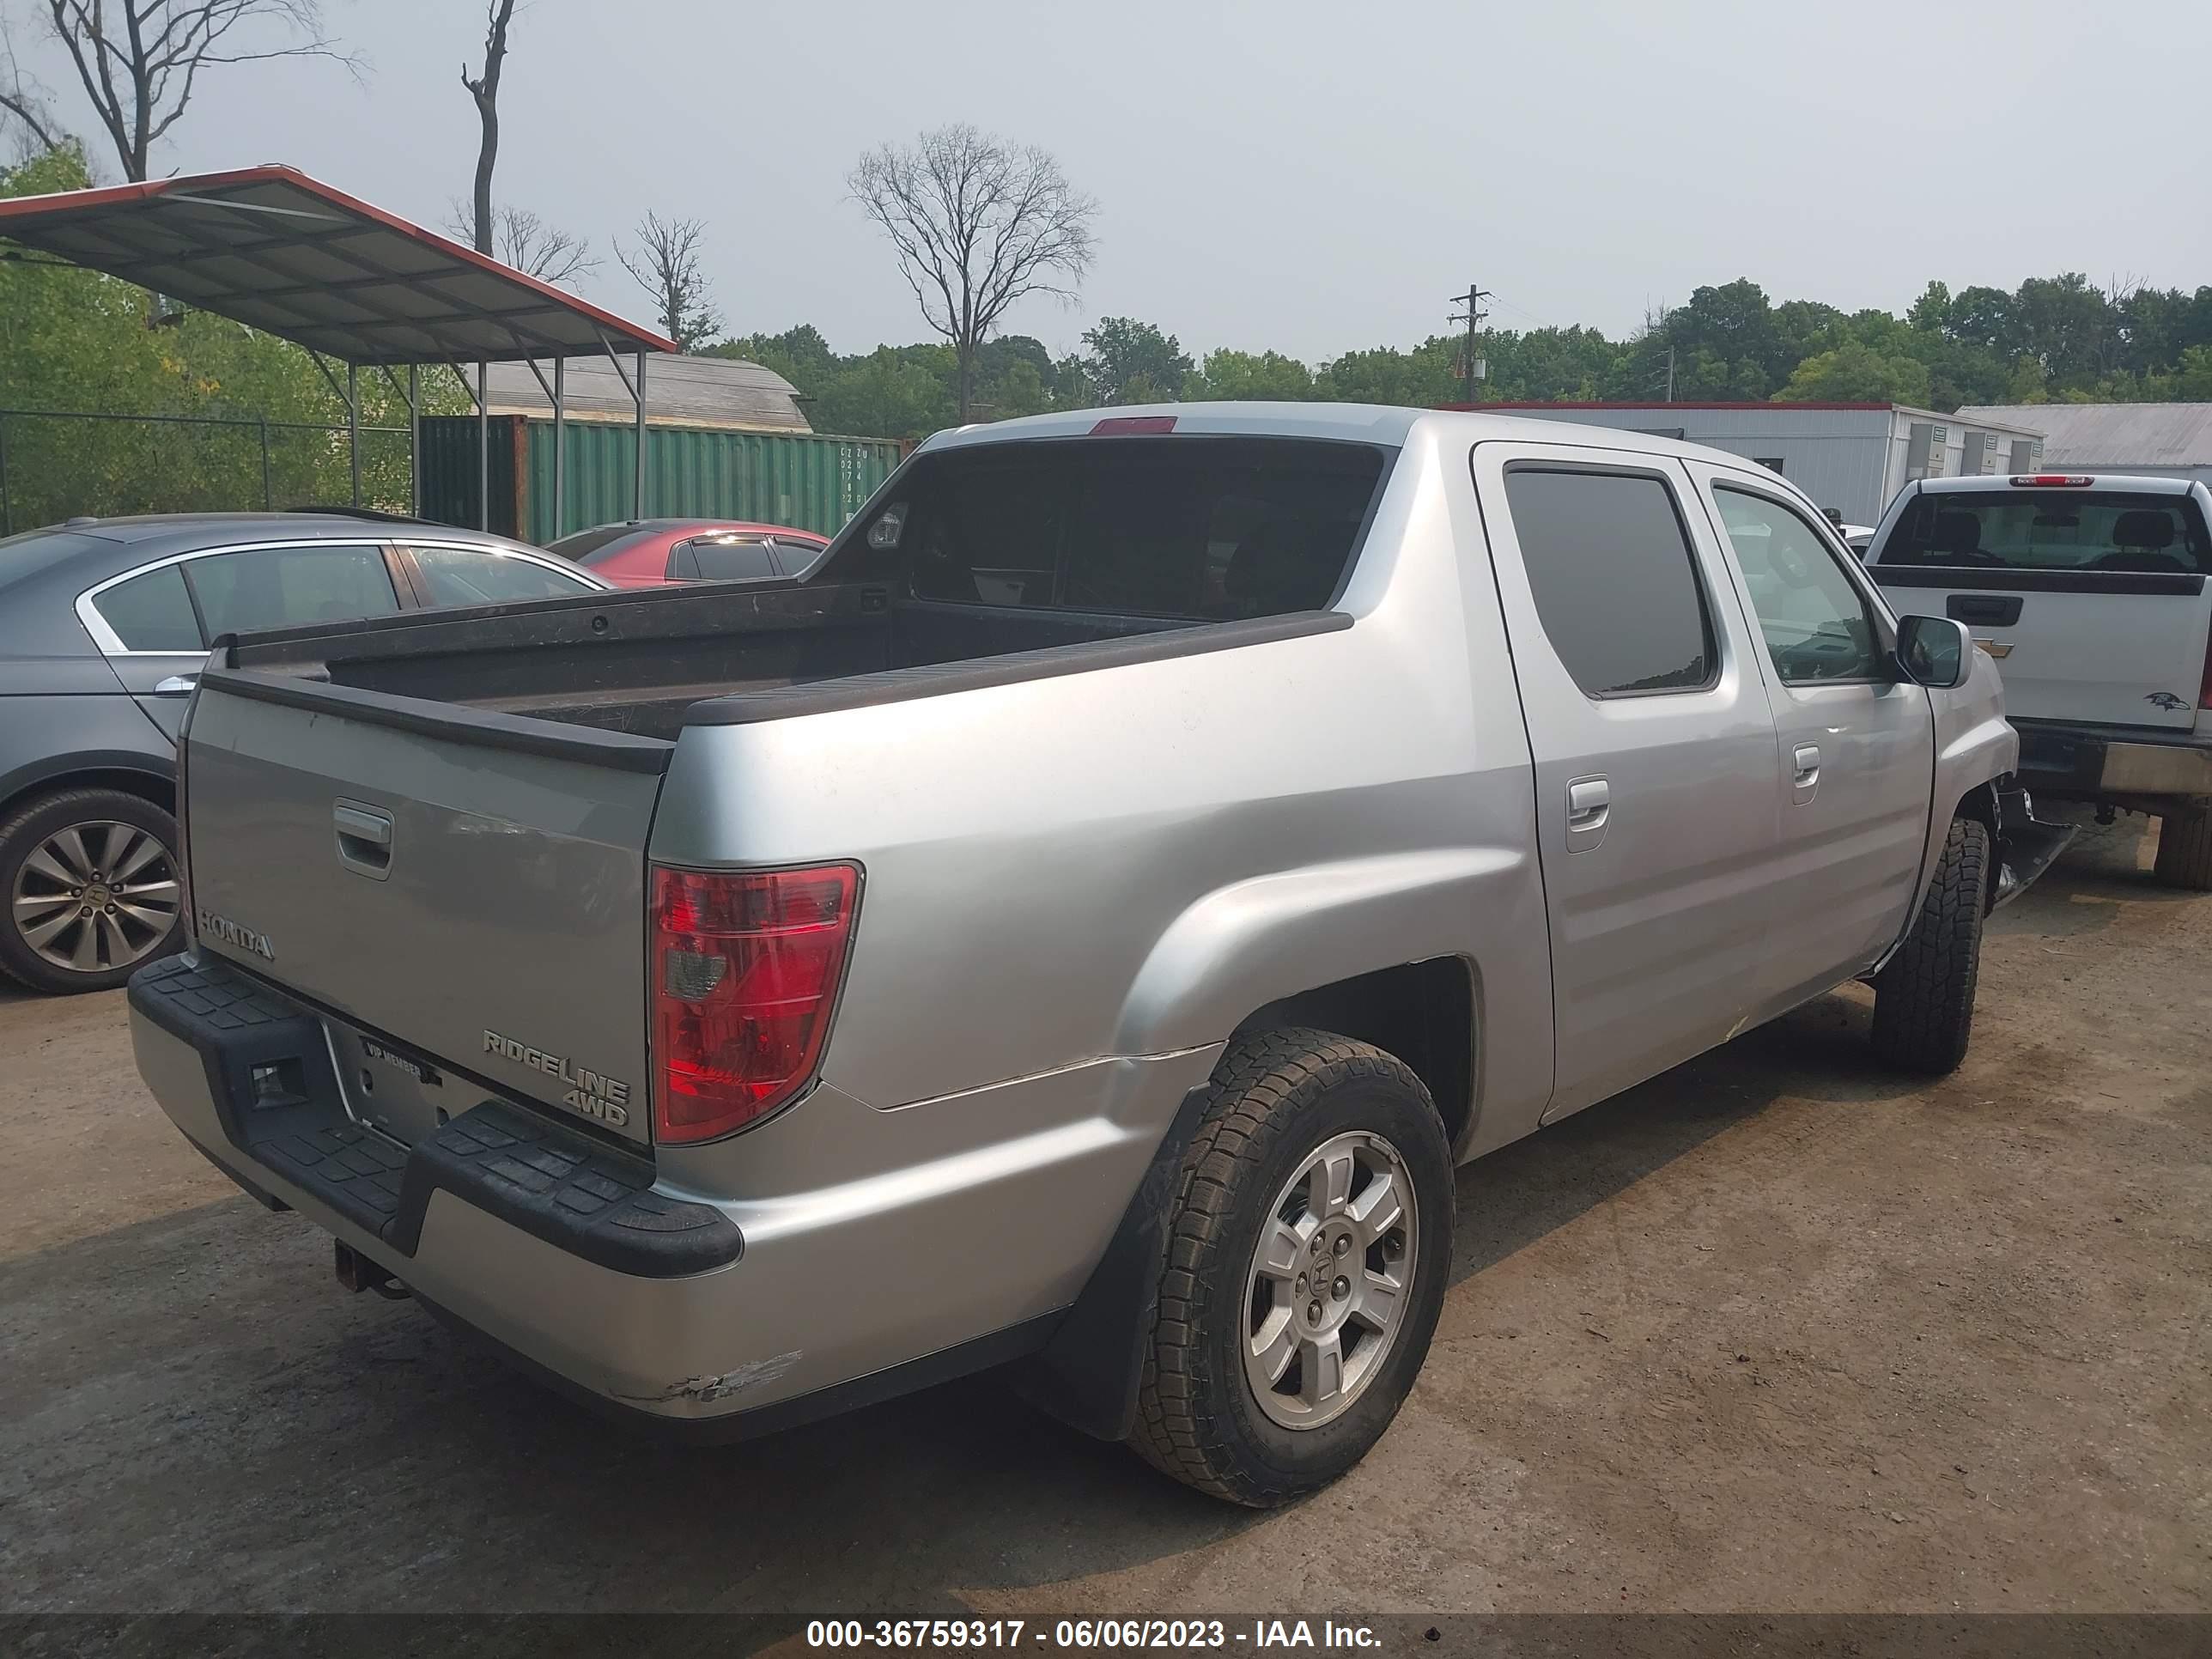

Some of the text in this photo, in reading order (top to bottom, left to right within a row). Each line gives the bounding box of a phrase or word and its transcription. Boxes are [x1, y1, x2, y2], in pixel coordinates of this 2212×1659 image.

[200, 908, 276, 960] HONDA
[483, 1029, 631, 1105] RIDGELINE
[562, 1089, 629, 1127] 4WD
